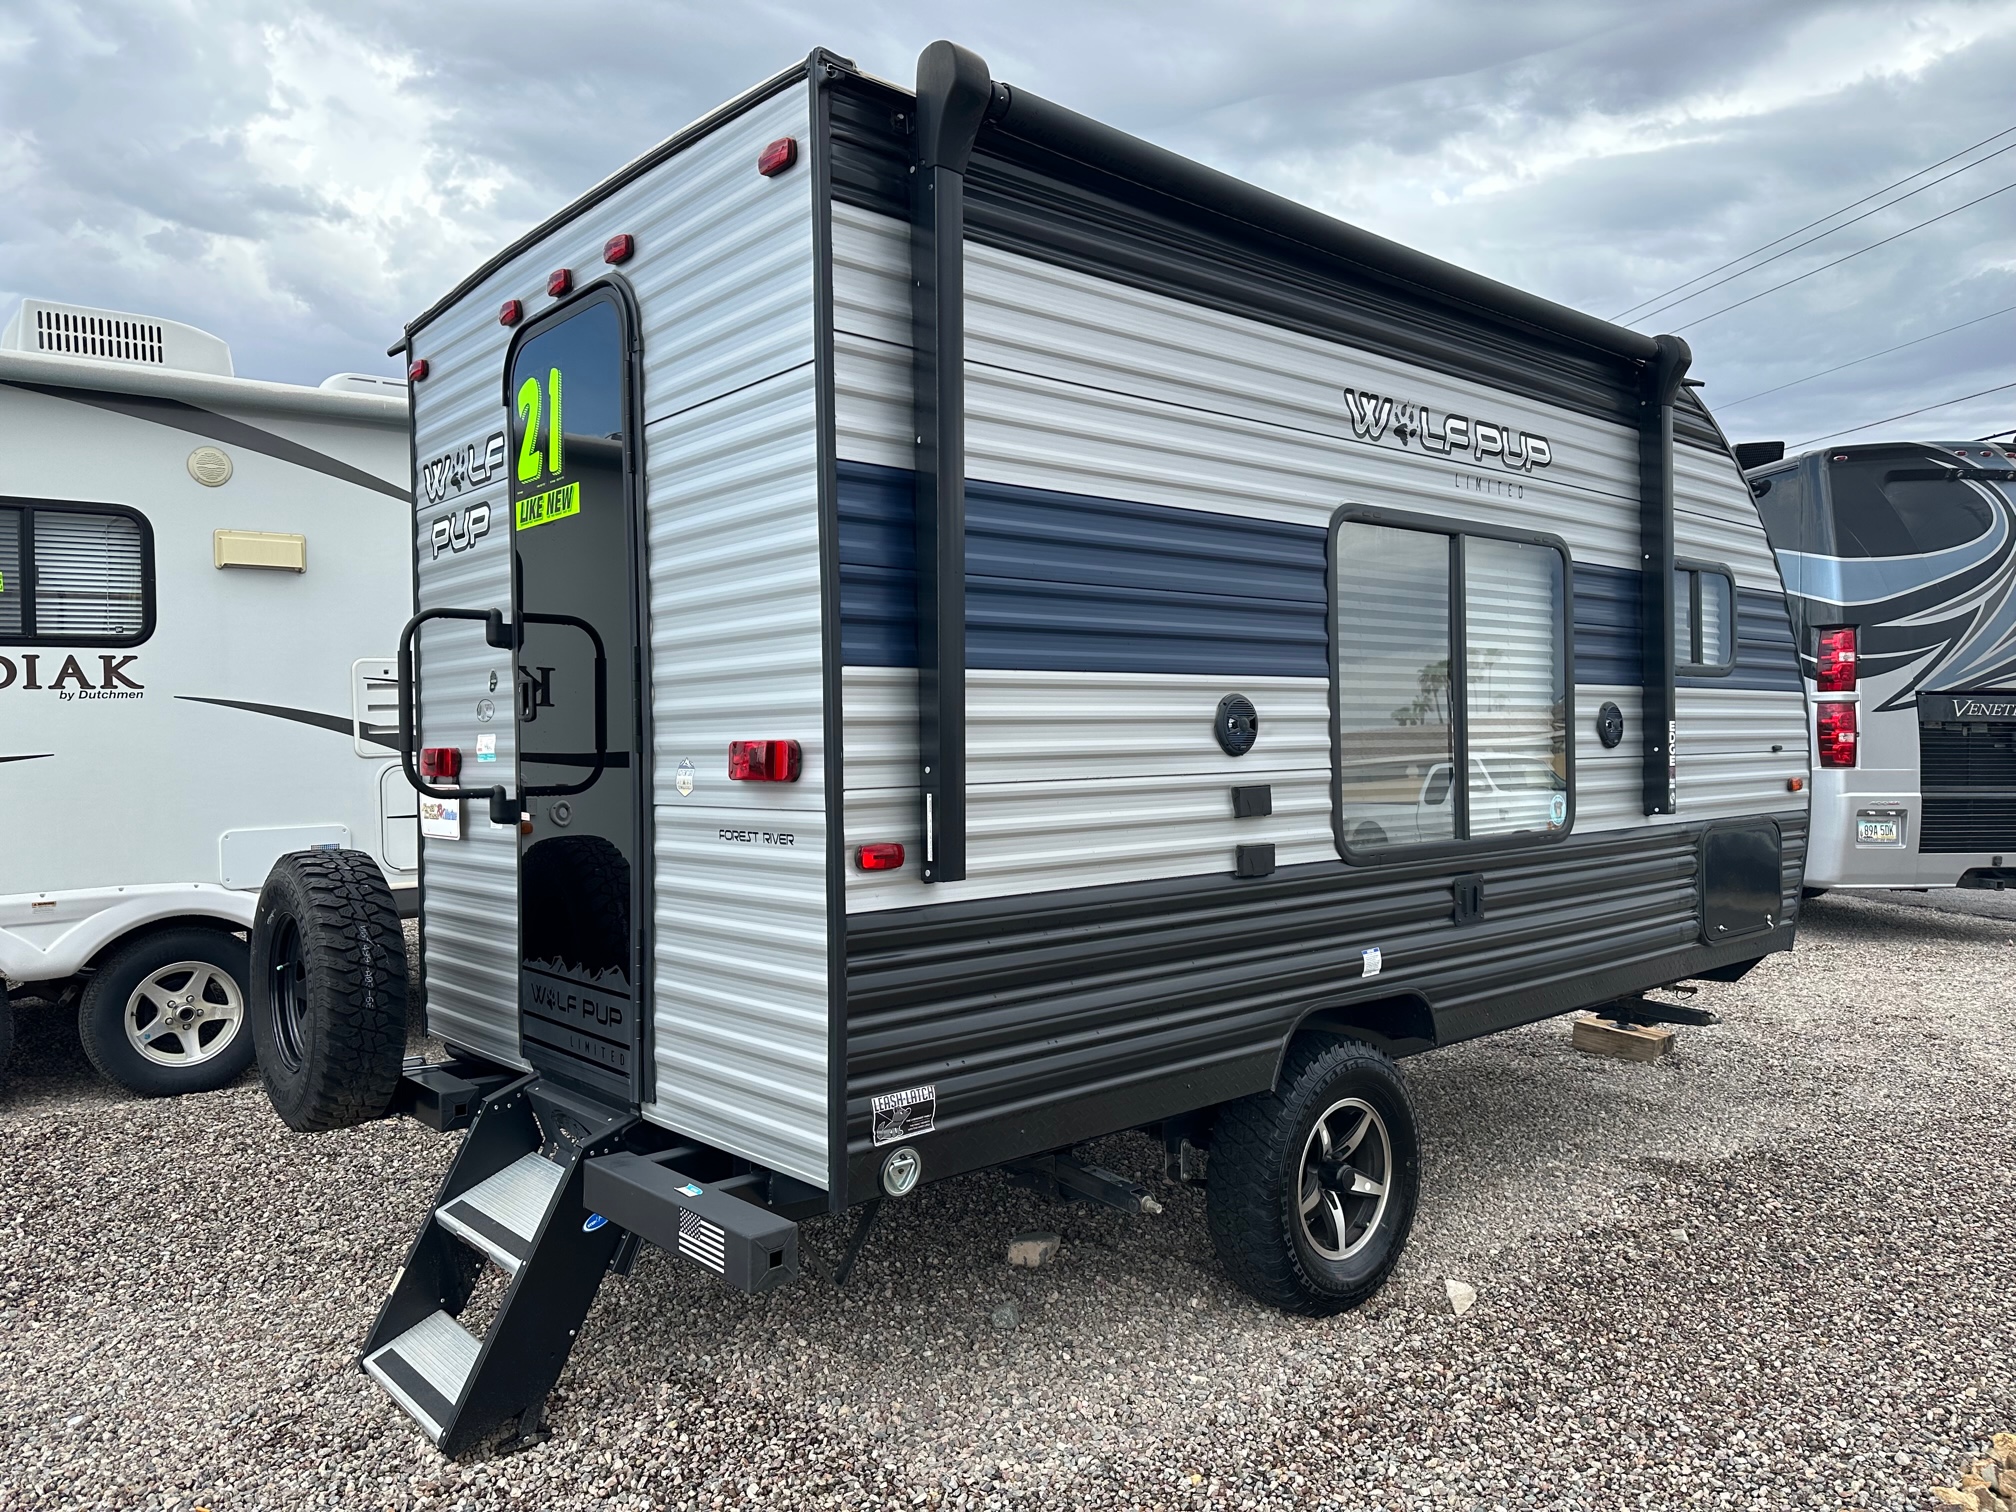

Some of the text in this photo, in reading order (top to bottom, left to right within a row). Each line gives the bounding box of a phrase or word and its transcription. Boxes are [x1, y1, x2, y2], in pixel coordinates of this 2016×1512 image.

[517, 367, 563, 485] 21
[1473, 419, 1553, 473] PUP
[1455, 473, 1524, 499] LIMITED
[519, 486, 575, 525] LIKE NEW
[431, 500, 491, 560] PUP
[59, 690, 144, 701] by Dutchmen
[1668, 720, 1676, 767] EDGE
[719, 829, 795, 846] FOREST RIVER
[582, 998, 623, 1028] PUP
[570, 1035, 625, 1066] LIMITED
